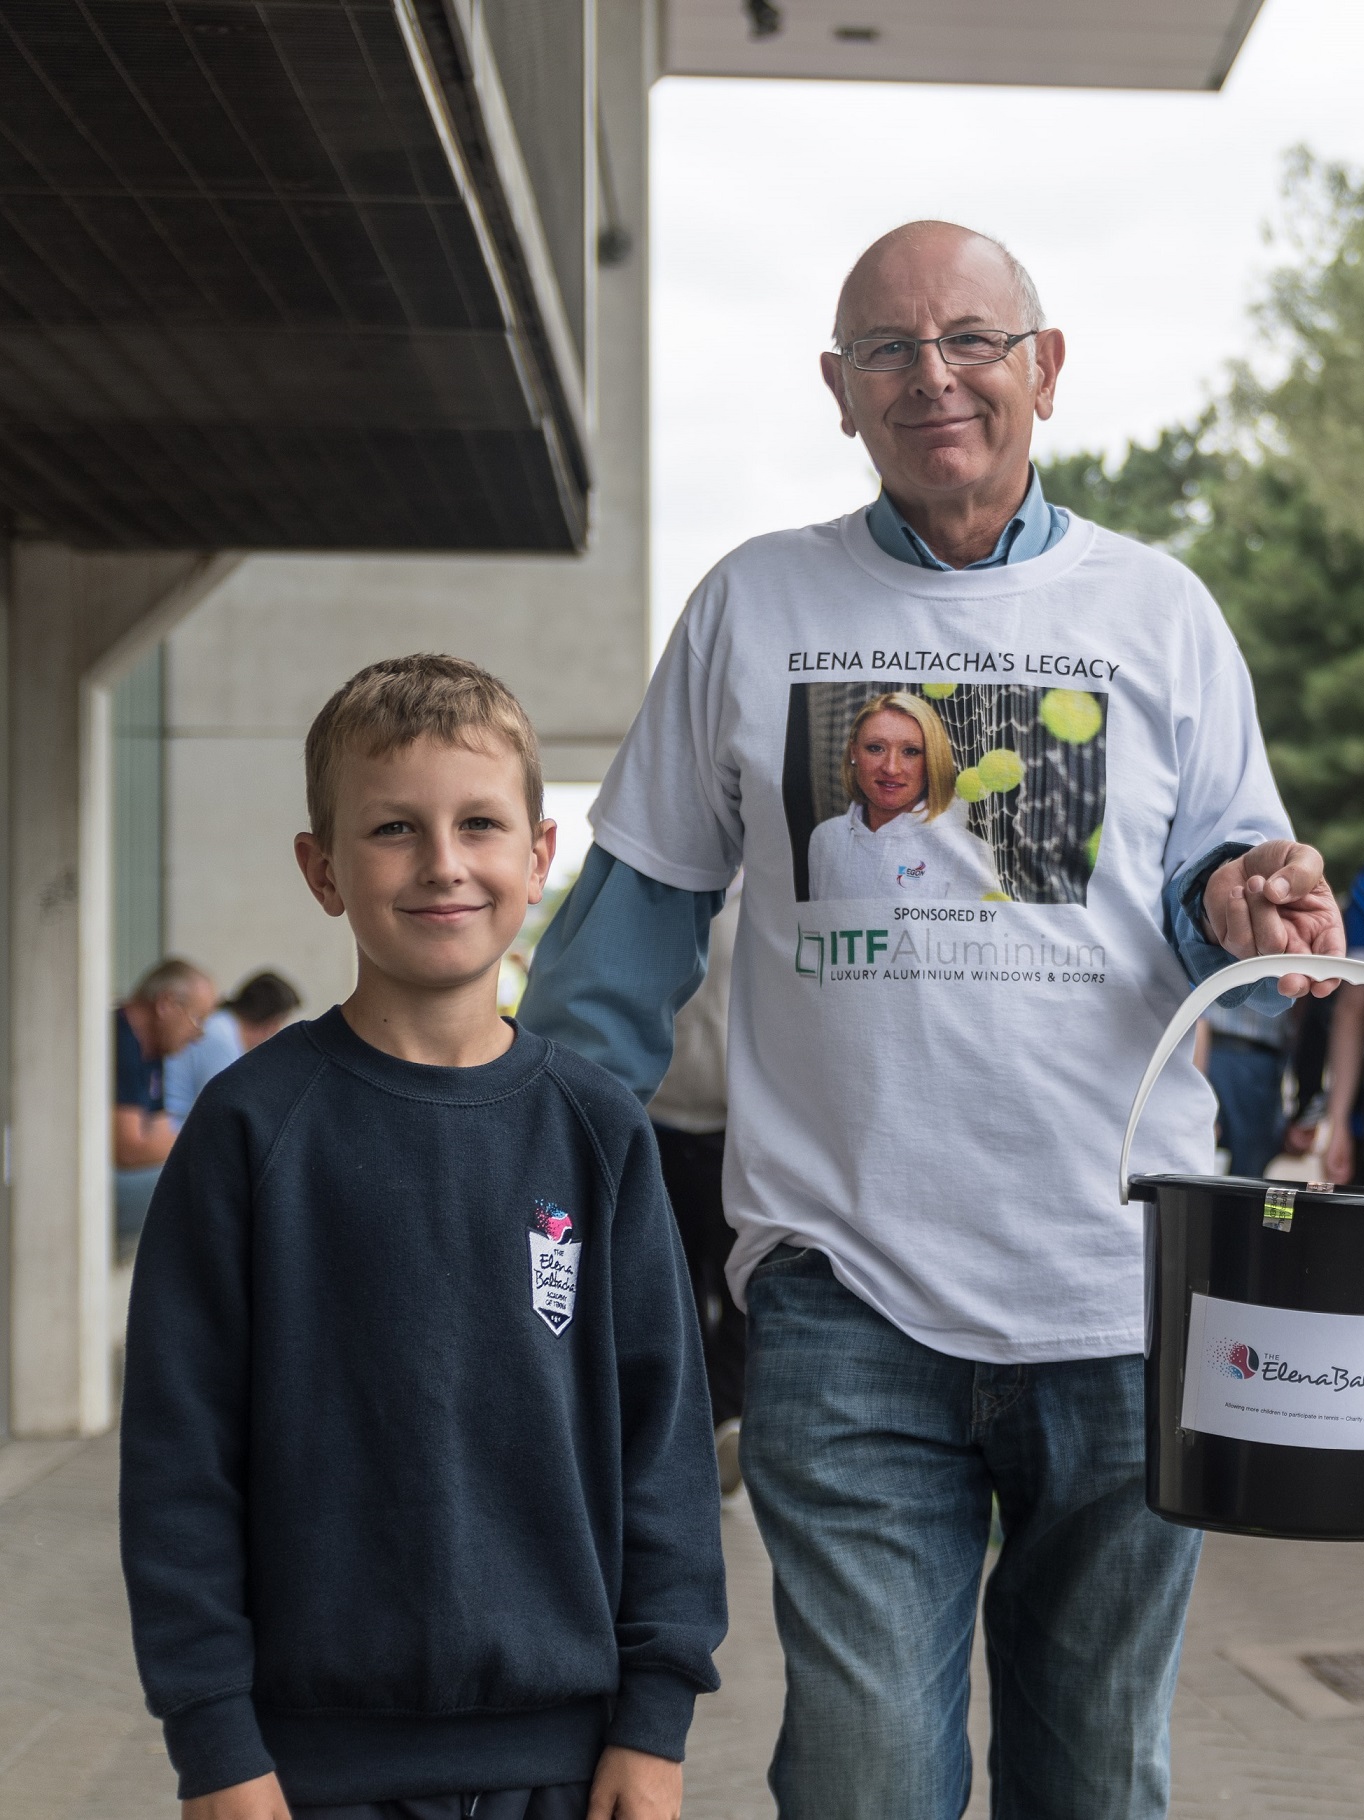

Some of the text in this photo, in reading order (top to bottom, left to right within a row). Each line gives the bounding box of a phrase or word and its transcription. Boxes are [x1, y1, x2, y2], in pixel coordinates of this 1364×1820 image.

[788, 650, 1120, 682] ELENA BALTACHA'S LEGACY
[894, 908, 997, 922] SPONSORED BY
[830, 970, 1106, 984] LUXURY ALUMINIUM WINDOWS & DOORS
[540, 1254, 573, 1274] Elena
[1264, 1352, 1280, 1361] THE
[1224, 1402, 1245, 1411] Allowing
[1260, 1408, 1281, 1416] children
[1289, 1412, 1317, 1420] participate
